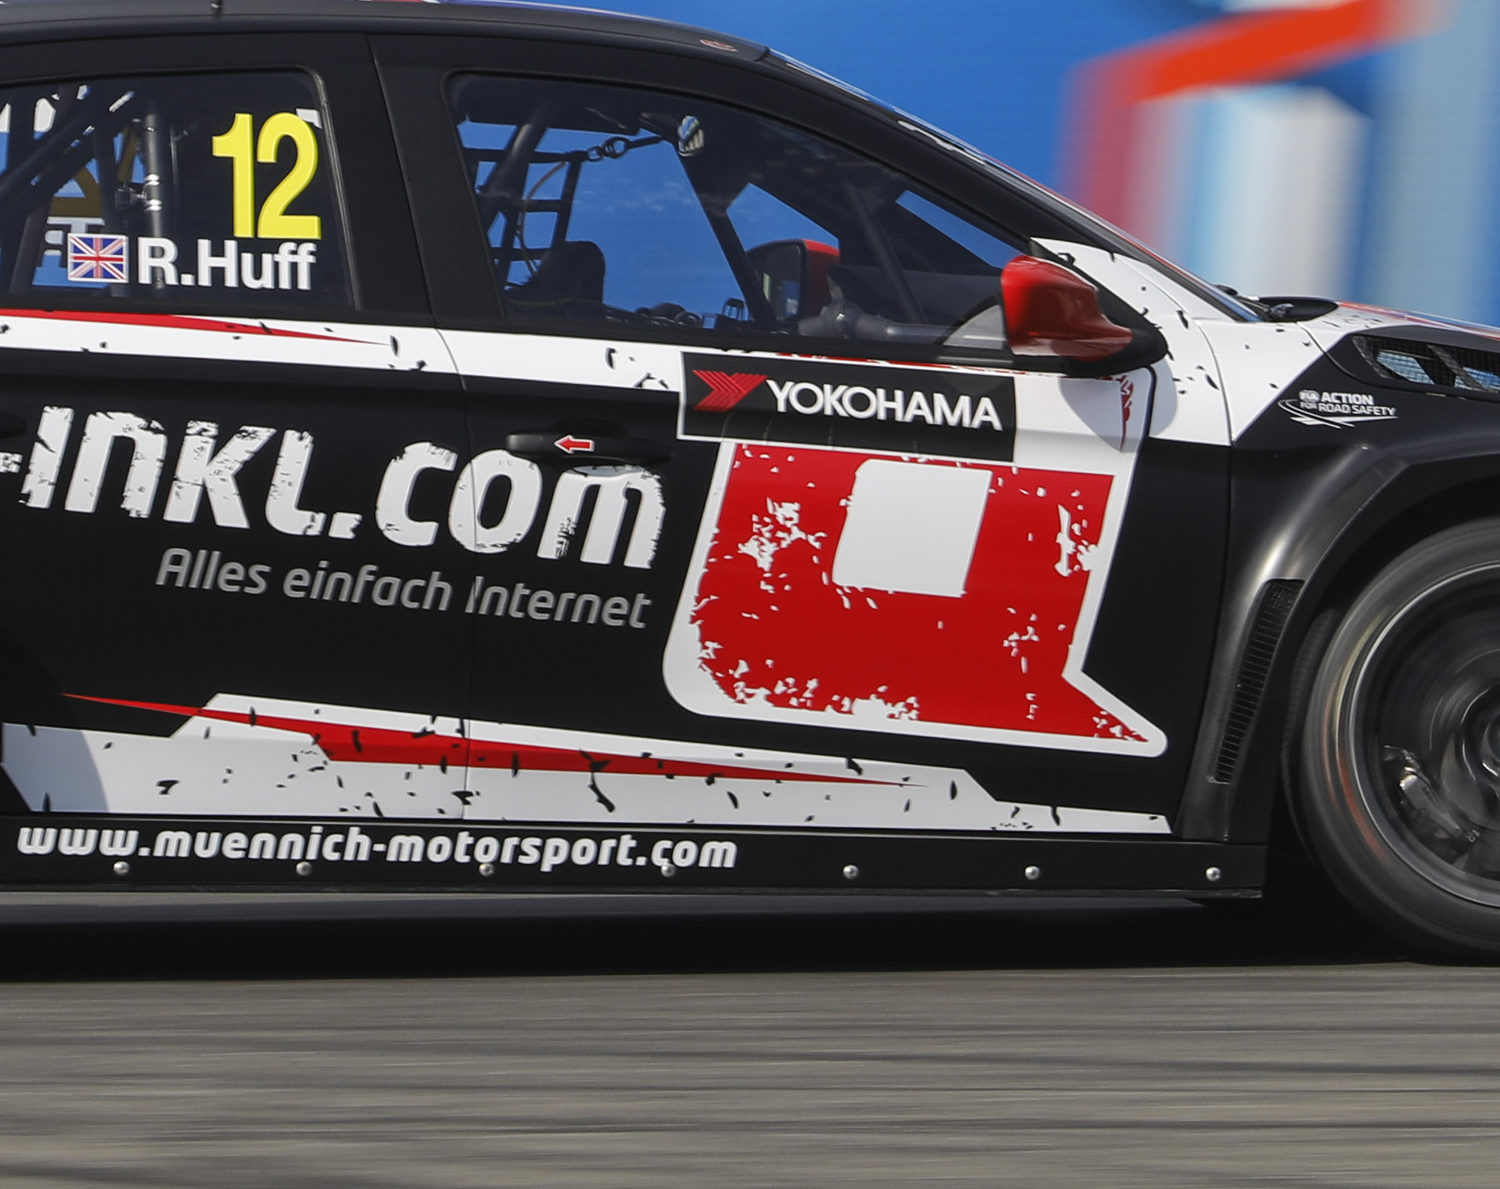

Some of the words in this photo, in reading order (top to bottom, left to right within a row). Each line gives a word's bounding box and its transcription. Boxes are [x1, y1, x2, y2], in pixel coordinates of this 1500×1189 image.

[212, 112, 321, 239] 12
[137, 236, 316, 290] R.Huff
[765, 379, 1002, 431] YOKOHAMA
[1318, 402, 1351, 414] ROAD
[1352, 404, 1396, 416] SAFETY
[1320, 392, 1374, 405] ACTION
[155, 547, 268, 594] Alles
[283, 560, 452, 611] einfach
[465, 574, 652, 630] Internet
[17, 823, 738, 873] www.muennich-motorsport.com
